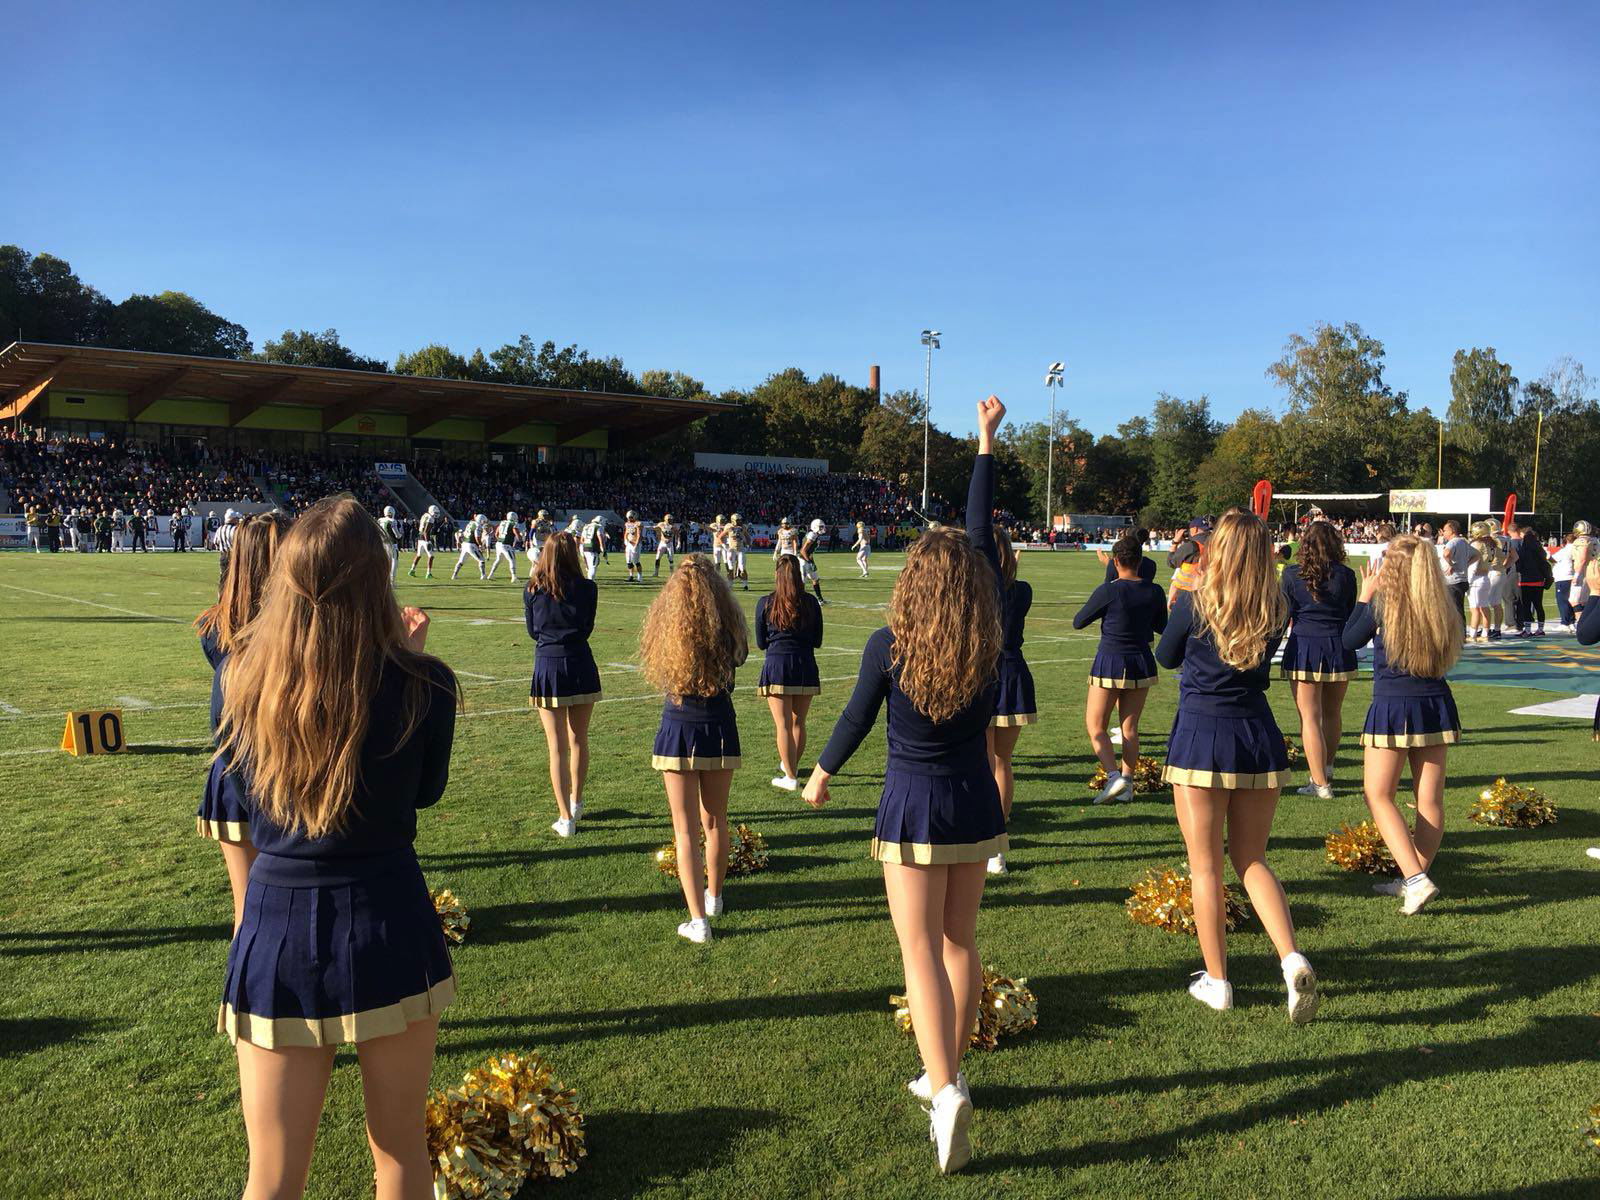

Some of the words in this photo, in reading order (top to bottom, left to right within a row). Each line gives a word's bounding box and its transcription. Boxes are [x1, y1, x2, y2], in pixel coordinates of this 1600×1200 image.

[744, 461, 783, 473] OPTIMA
[785, 464, 824, 475] Sportpark
[78, 713, 121, 754] 10
